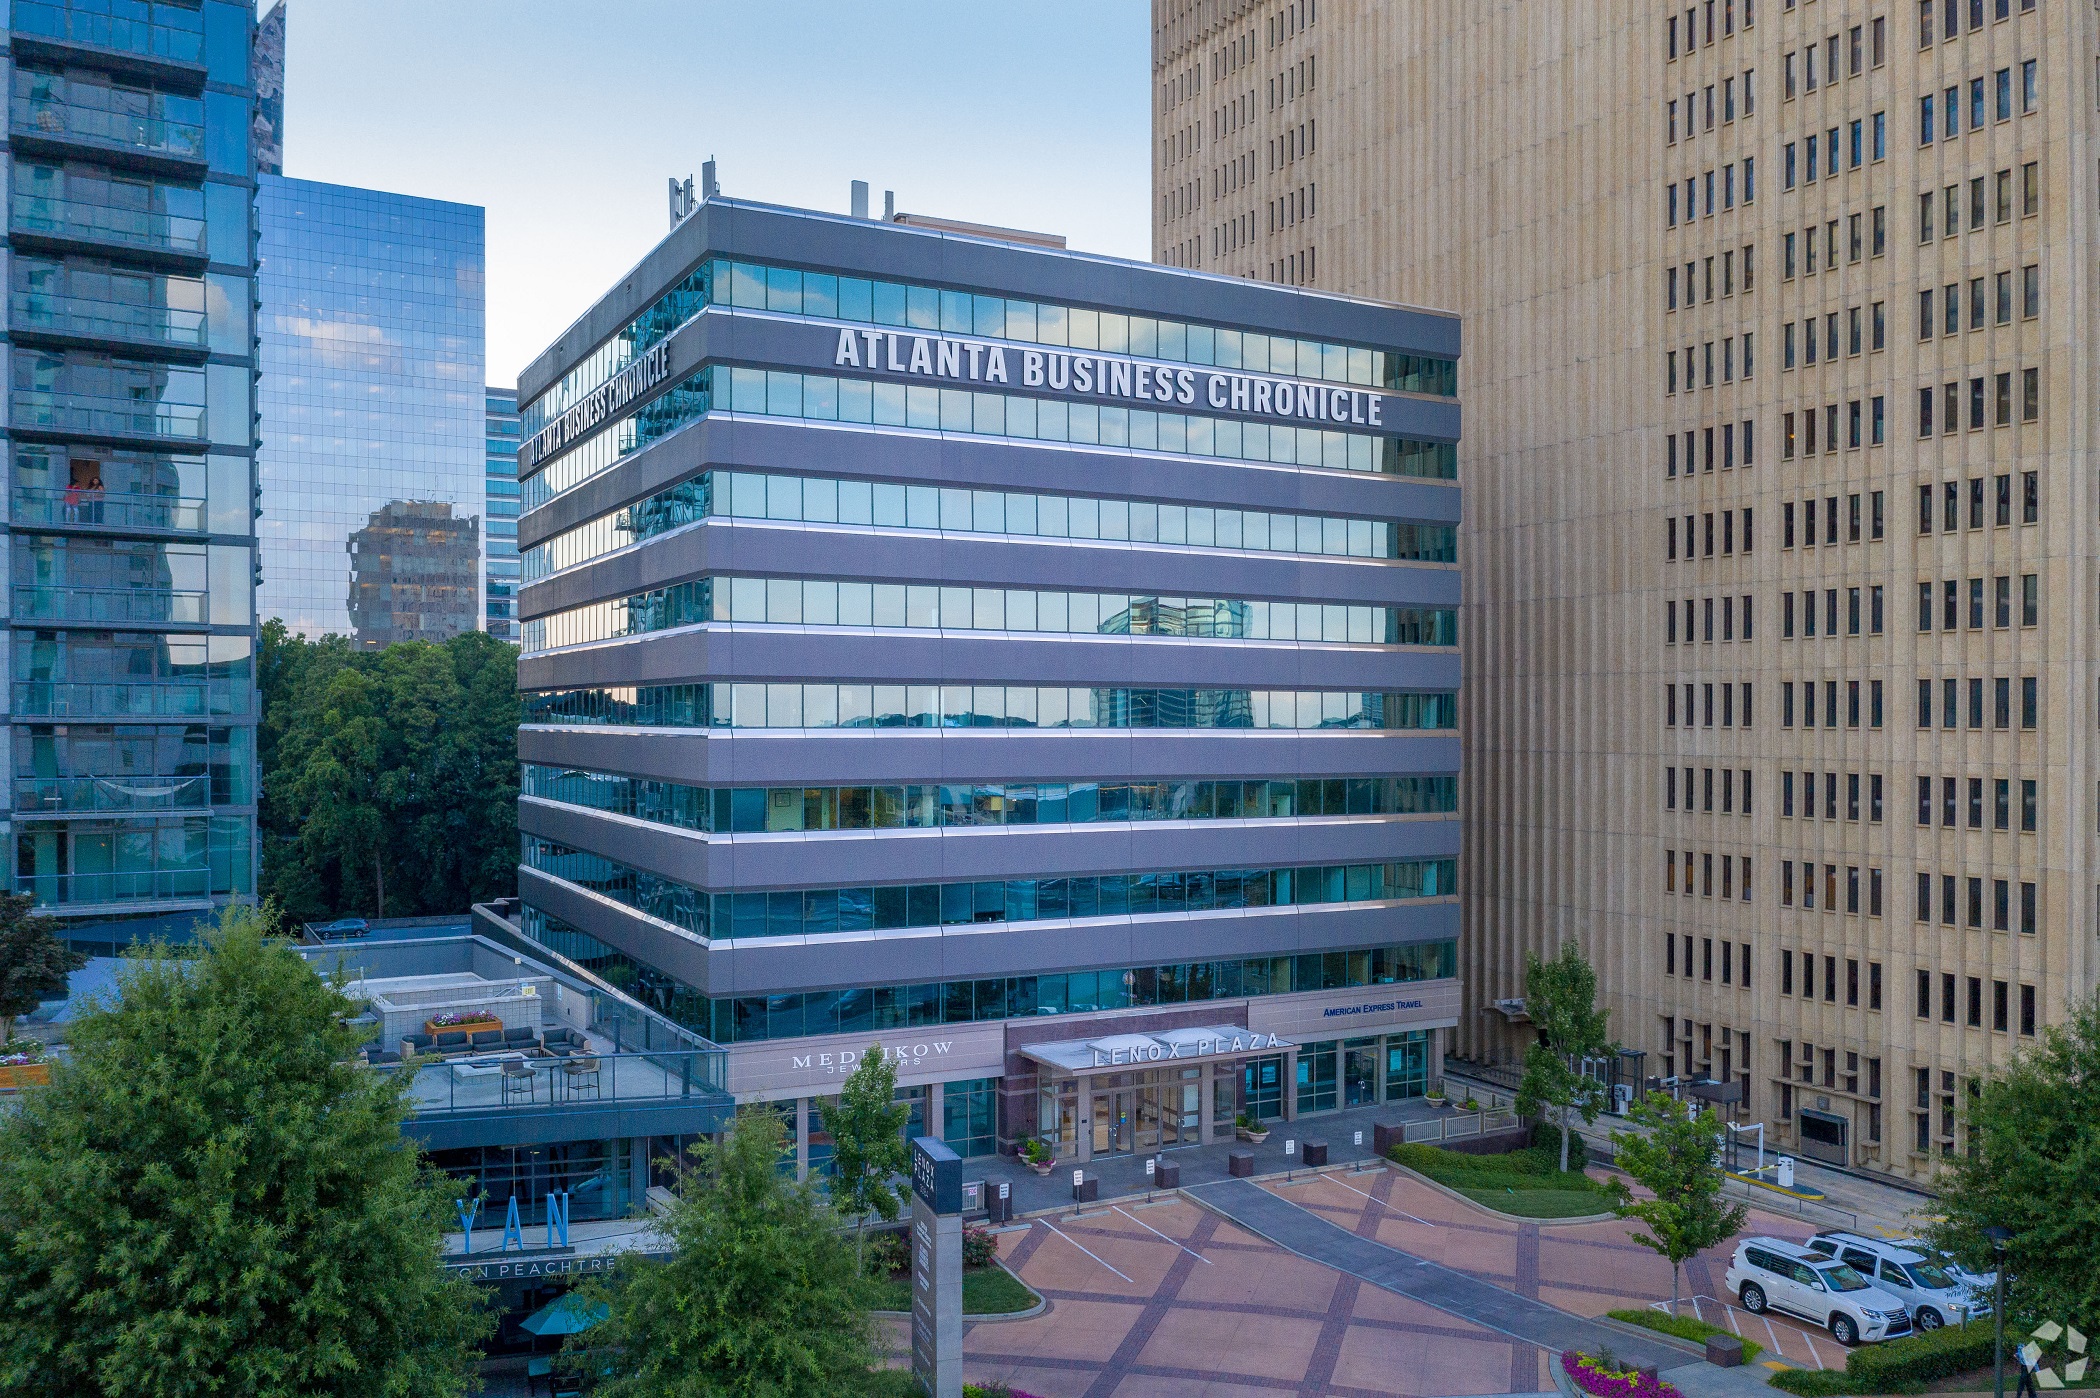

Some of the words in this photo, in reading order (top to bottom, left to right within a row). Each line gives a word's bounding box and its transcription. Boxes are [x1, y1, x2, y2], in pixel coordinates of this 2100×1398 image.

[836, 328, 1008, 383] ATLANTA
[1023, 350, 1195, 405] BUSINESS
[1208, 374, 1382, 426] CHRONICLE
[531, 420, 562, 466] ATLANTA
[564, 387, 606, 443] BUSINESS
[609, 341, 668, 413] CHRONICLE
[1323, 1007, 1361, 1018] AMERICAN
[1363, 1002, 1395, 1013] EXPRESS
[1396, 1000, 1423, 1010] TRAVEL
[792, 1041, 953, 1069] MEDIKOW
[1093, 1042, 1181, 1067] LENOX
[1198, 1032, 1280, 1056] PLAZA
[827, 1057, 921, 1074] JEWRS
[914, 1149, 935, 1180] LENOX
[914, 1162, 935, 1193] PLAZA
[456, 1193, 569, 1254] YAN
[500, 1257, 624, 1277] PEACHTRE
